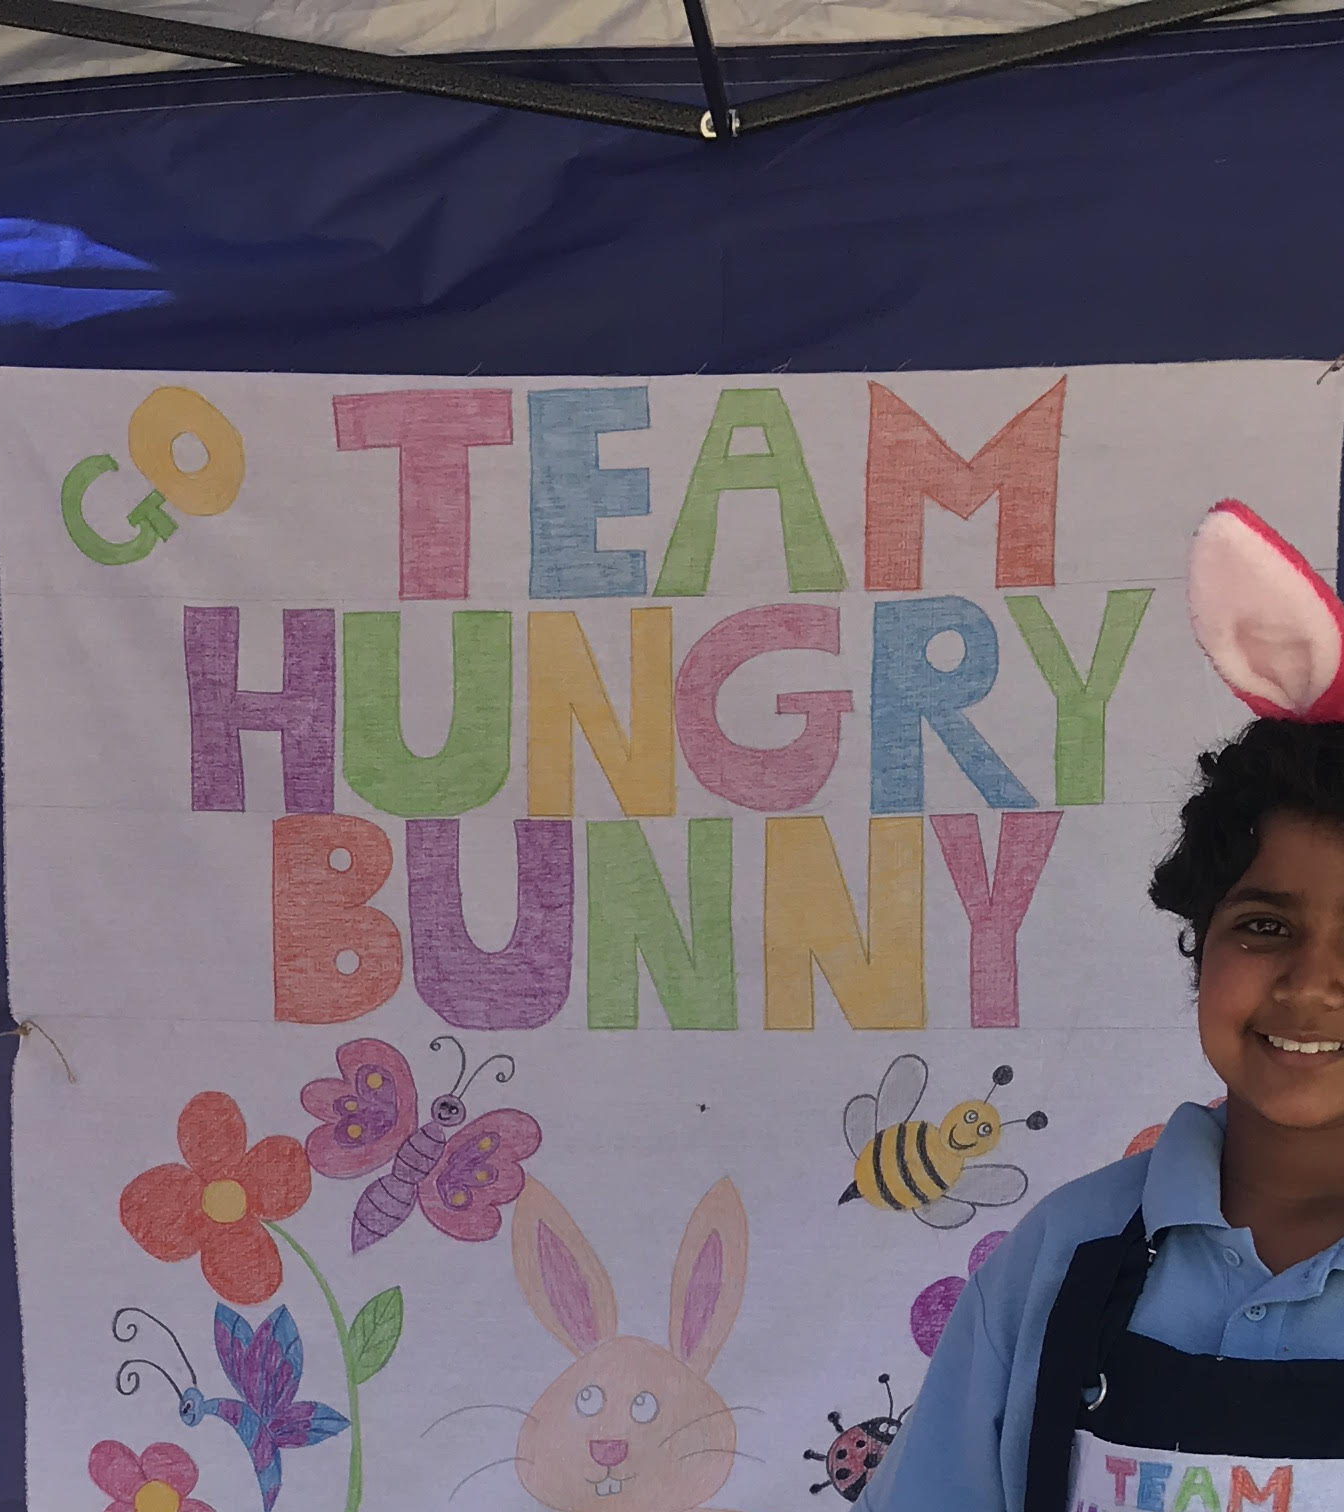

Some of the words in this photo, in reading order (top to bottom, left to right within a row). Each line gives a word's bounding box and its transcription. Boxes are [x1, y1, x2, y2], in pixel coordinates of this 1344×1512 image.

[61, 386, 245, 565] GO
[333, 375, 1067, 600] TEAM
[184, 588, 1154, 817] HUNGRY
[272, 811, 1063, 1030] BUNNY
